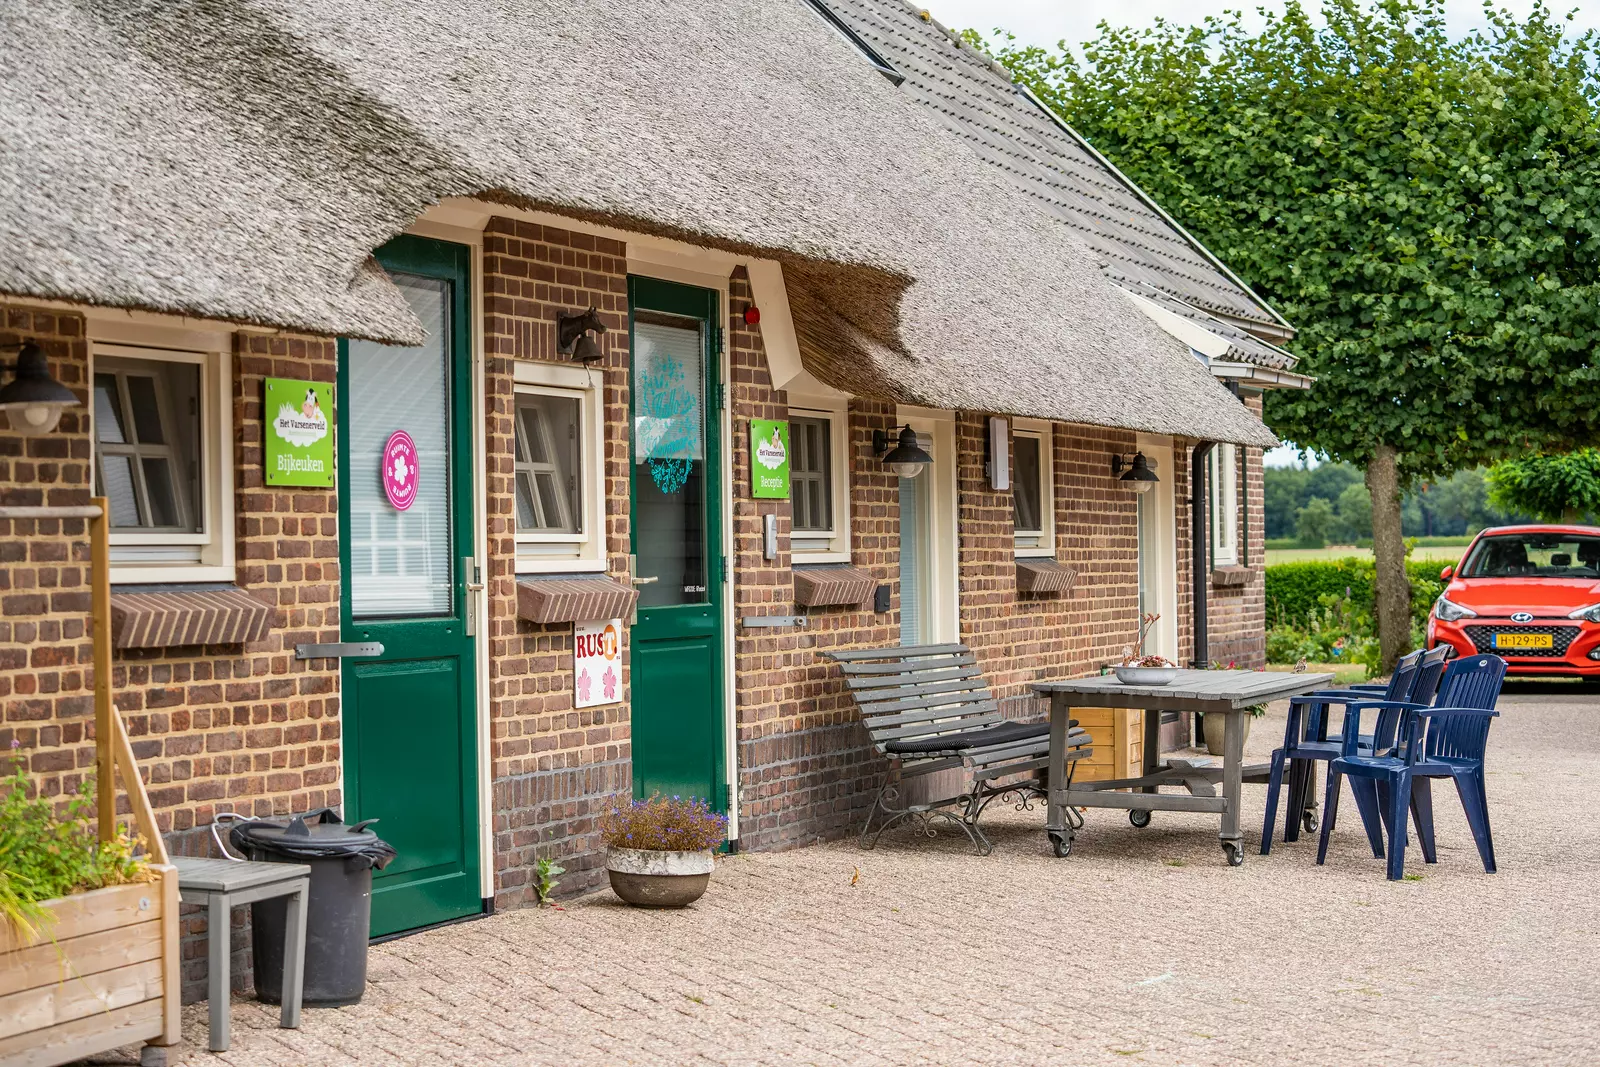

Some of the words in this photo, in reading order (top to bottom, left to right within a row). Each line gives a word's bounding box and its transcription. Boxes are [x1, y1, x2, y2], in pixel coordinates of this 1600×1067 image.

[280, 419, 289, 428] Het
[391, 444, 410, 458] RUIMTE
[277, 454, 324, 476] Bijkeuken
[761, 475, 783, 491] Receptie
[1500, 635, 1548, 646] H-129-PS
